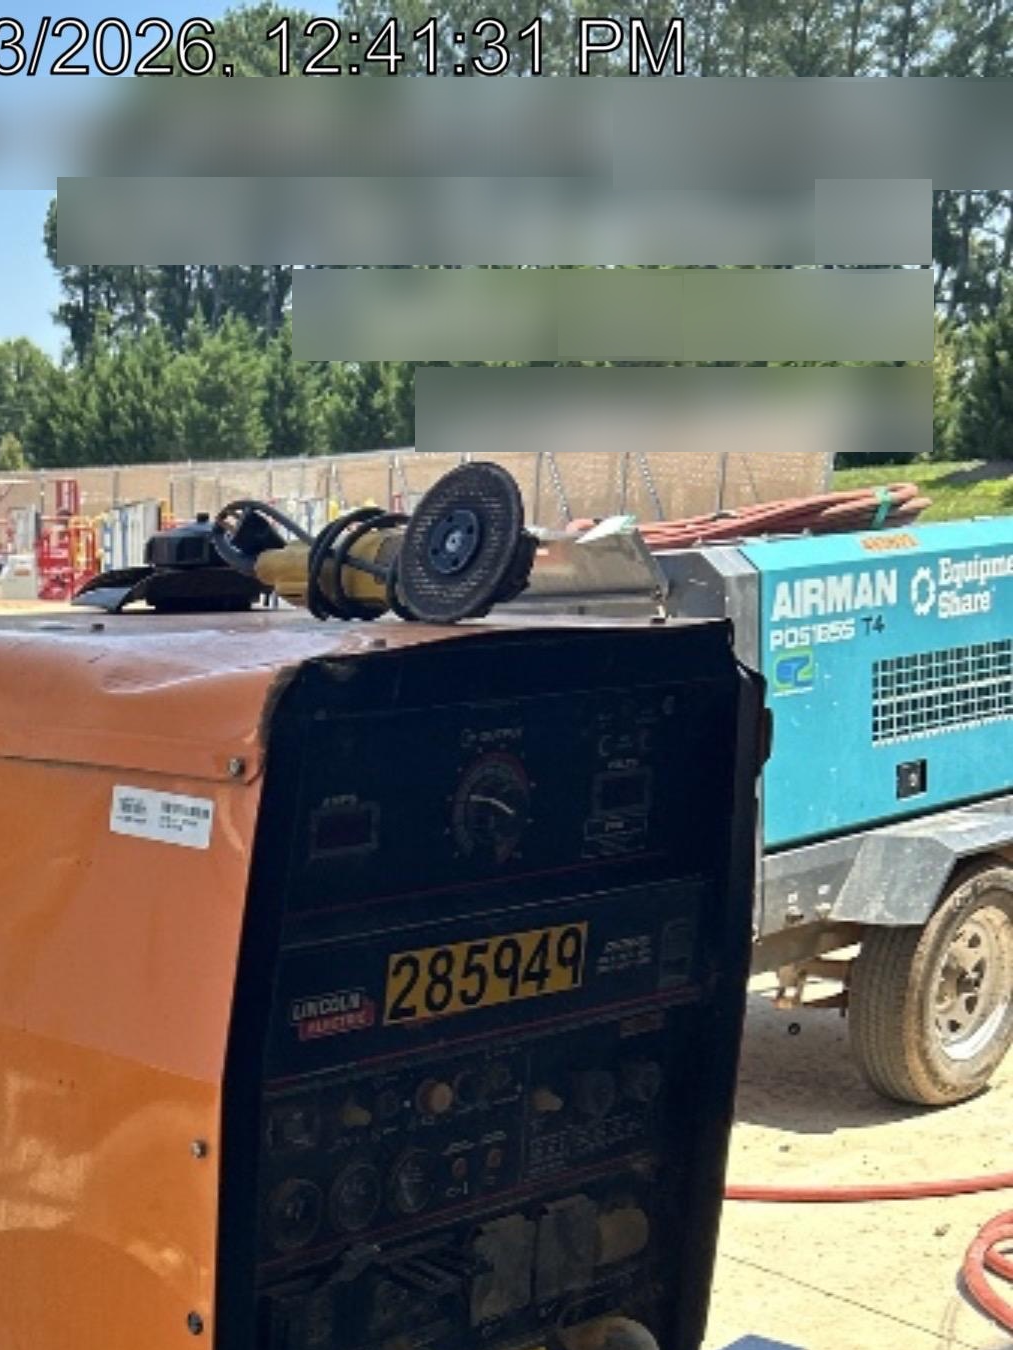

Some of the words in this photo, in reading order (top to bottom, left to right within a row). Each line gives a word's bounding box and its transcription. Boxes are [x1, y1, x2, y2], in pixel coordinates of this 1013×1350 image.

[770, 569, 898, 622] AIRMAN
[938, 591, 990, 619] Share
[860, 614, 886, 637] T4
[388, 926, 583, 1020] 285949
